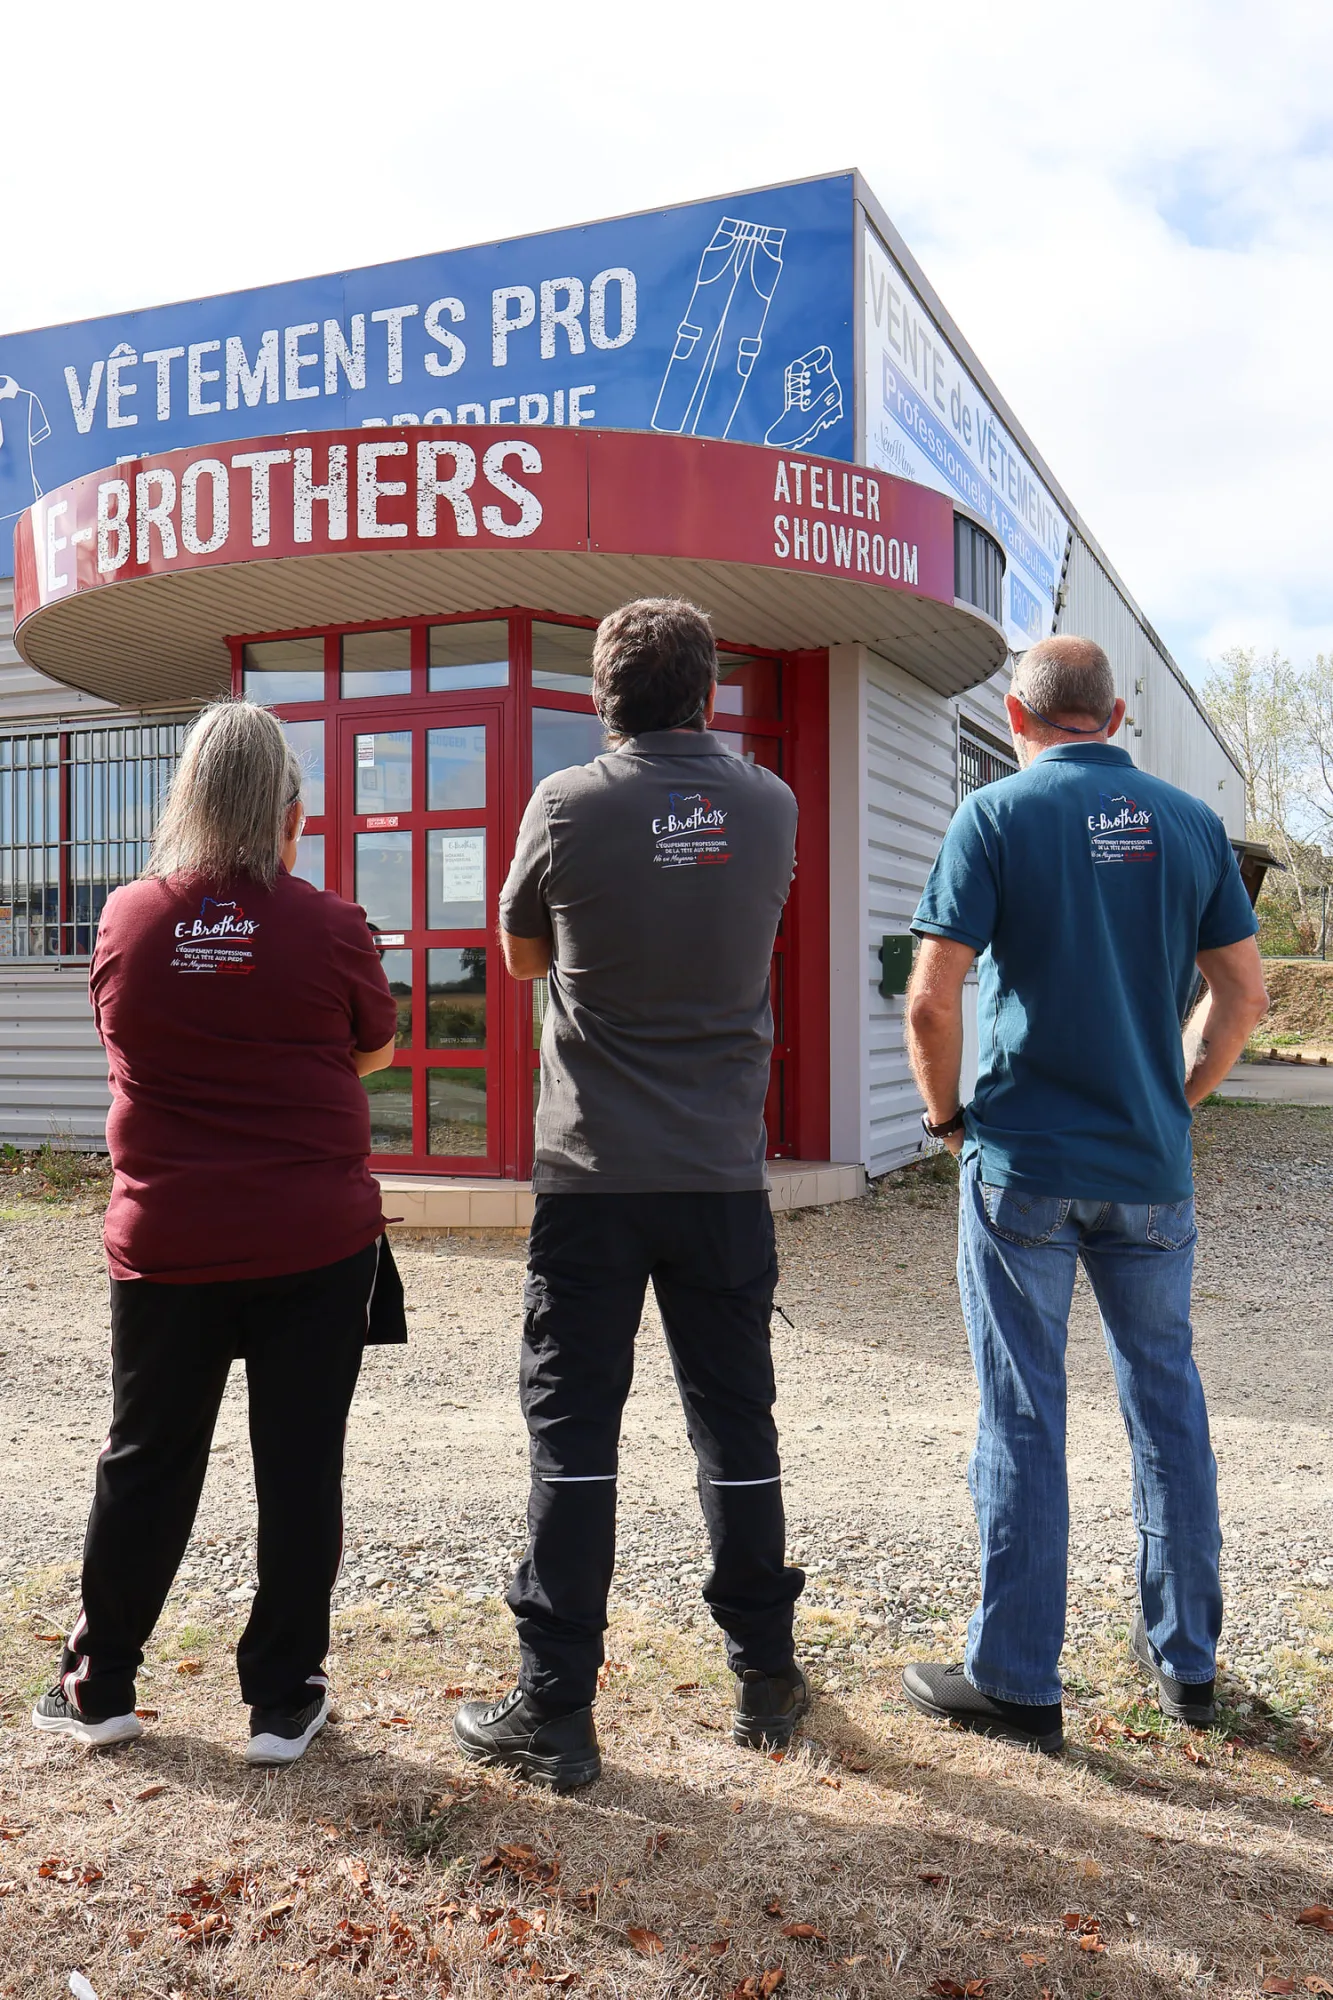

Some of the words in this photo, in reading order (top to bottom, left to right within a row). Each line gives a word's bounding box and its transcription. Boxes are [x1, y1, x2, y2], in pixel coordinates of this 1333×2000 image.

[64, 297, 466, 434] VÊTEMENTS
[491, 267, 638, 368] PRO
[869, 254, 946, 413] VENTE
[951, 381, 972, 446] de
[976, 407, 1060, 562] VÊTEMENTS
[886, 367, 987, 514] Professionnels
[47, 440, 543, 591] E-BROTHERS
[773, 460, 881, 523] ATELIER
[773, 514, 920, 587] SHOWROOM
[652, 807, 728, 835] E-Brothers
[1088, 808, 1152, 831] E-Brothers
[174, 915, 260, 938] E-Brothers
